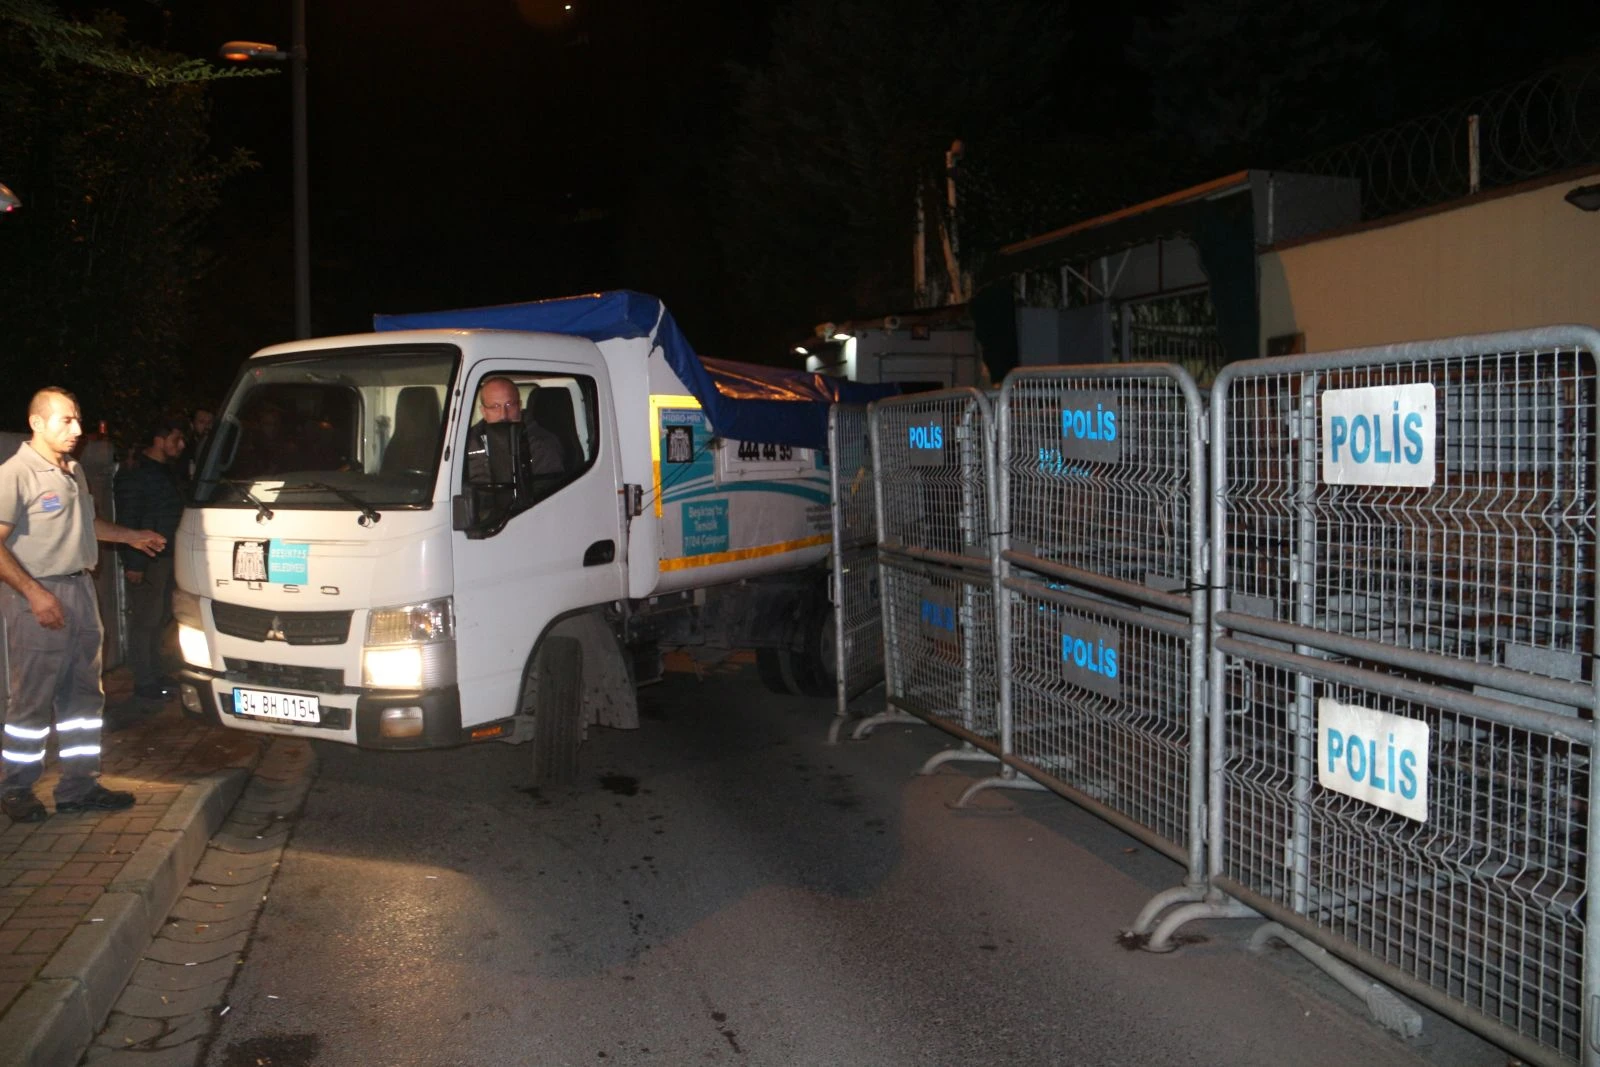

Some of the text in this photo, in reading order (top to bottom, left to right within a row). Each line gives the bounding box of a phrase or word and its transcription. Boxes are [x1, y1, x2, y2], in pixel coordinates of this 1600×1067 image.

[908, 421, 943, 449] POLİS
[1061, 402, 1117, 442] POLİS
[1331, 401, 1424, 465] POLİS
[216, 579, 340, 595] FUSO
[1062, 634, 1117, 679] POLİS
[243, 694, 315, 718] 34 BH 0154
[1328, 728, 1417, 800] POLİS
